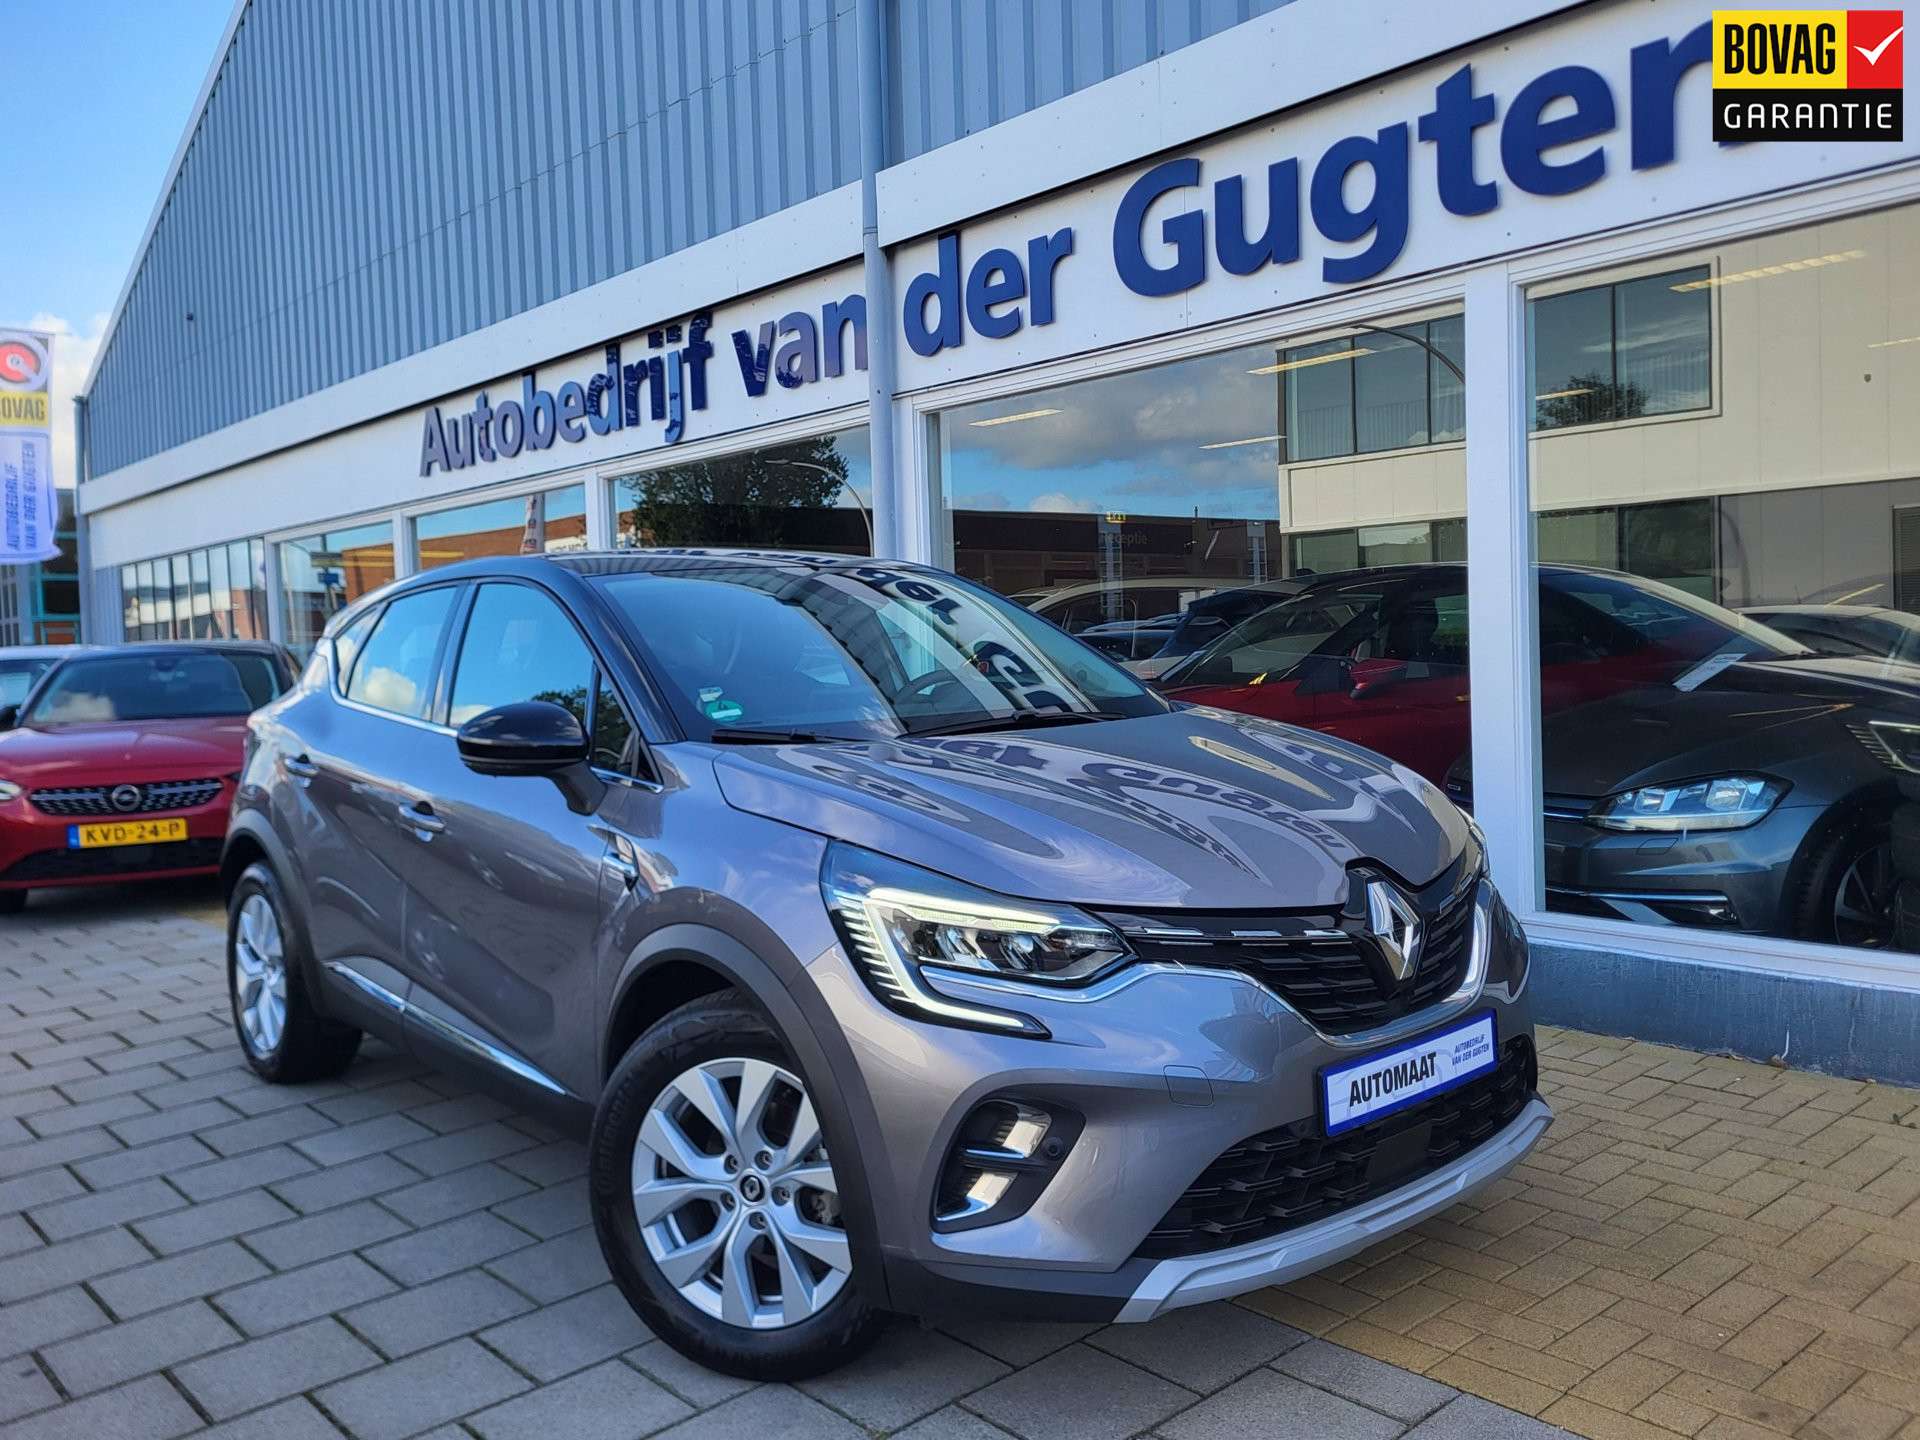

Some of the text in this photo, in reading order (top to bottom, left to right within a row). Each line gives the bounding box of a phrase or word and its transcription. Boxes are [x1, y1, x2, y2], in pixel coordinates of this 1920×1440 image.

[420, 311, 714, 477] Autobedrijf
[731, 294, 868, 397] van
[903, 225, 1073, 358] der
[0, 398, 46, 421] OVAG
[86, 822, 181, 842] KVD-24-P
[1350, 1052, 1437, 1107] AUTOMAAT
